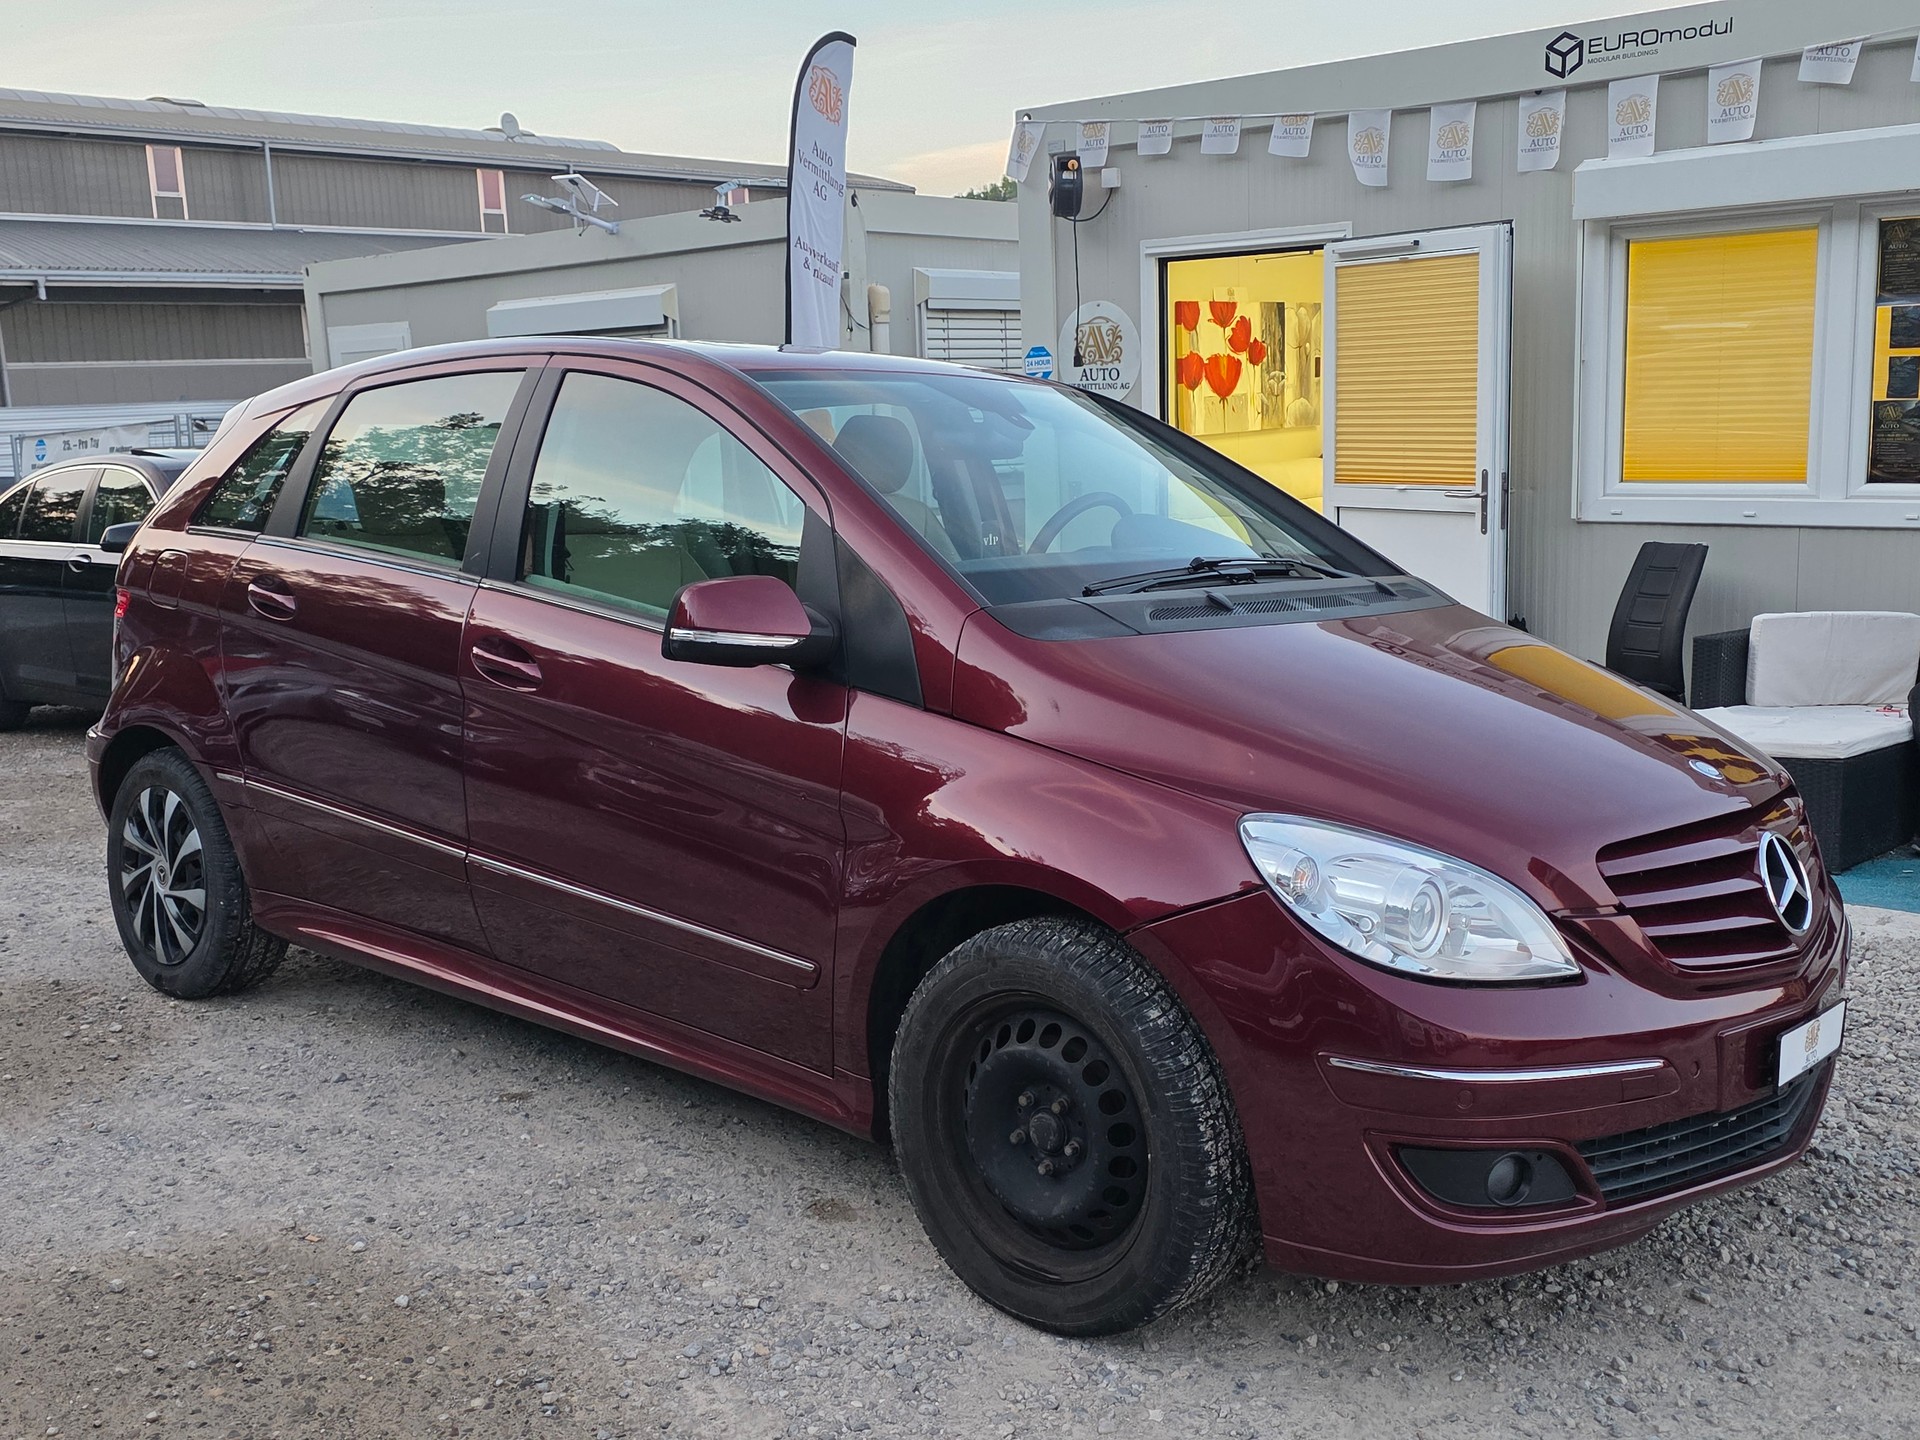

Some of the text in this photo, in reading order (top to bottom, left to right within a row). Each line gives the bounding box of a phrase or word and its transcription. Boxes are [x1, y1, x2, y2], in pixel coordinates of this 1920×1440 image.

[1588, 16, 1734, 55] EUROmodul
[1587, 48, 1659, 65] MODULAR BUILDINGS
[1816, 46, 1851, 57] AUTO
[1805, 55, 1847, 63] VERMITTLUNG
[1720, 105, 1751, 118] AUTO
[1146, 124, 1168, 134] AUTO
[1212, 124, 1235, 134] AUTO
[1282, 127, 1306, 135] AUTO
[1619, 123, 1649, 137] AUTO
[1084, 139, 1105, 148] AUTO
[1529, 136, 1557, 148] AUTO
[811, 139, 833, 167] Auto
[1439, 148, 1467, 159] AUTO
[1356, 155, 1382, 164] AUTO
[797, 149, 844, 197] Vermittlung
[813, 181, 827, 202] AG
[803, 256, 811, 271] &
[1080, 368, 1120, 381] AUTO
[1069, 382, 1130, 390] ERMITTLUNG AG
